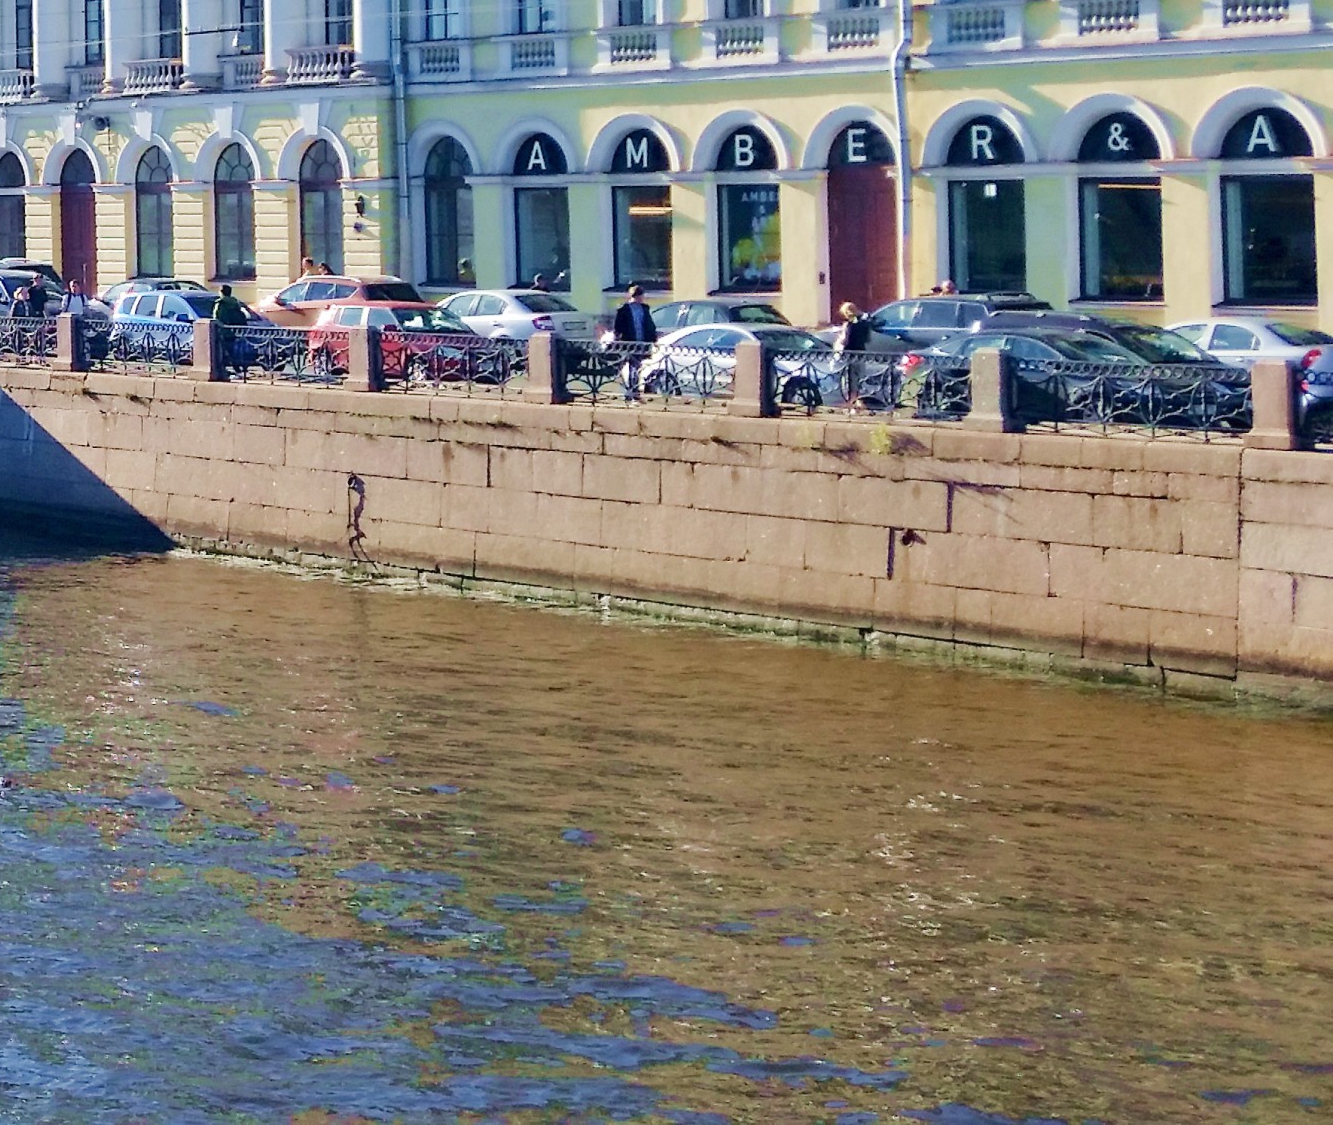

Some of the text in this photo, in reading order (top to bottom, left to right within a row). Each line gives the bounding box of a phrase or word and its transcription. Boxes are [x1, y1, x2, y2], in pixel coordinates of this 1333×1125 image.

[527, 114, 1278, 171] AMBER & A
